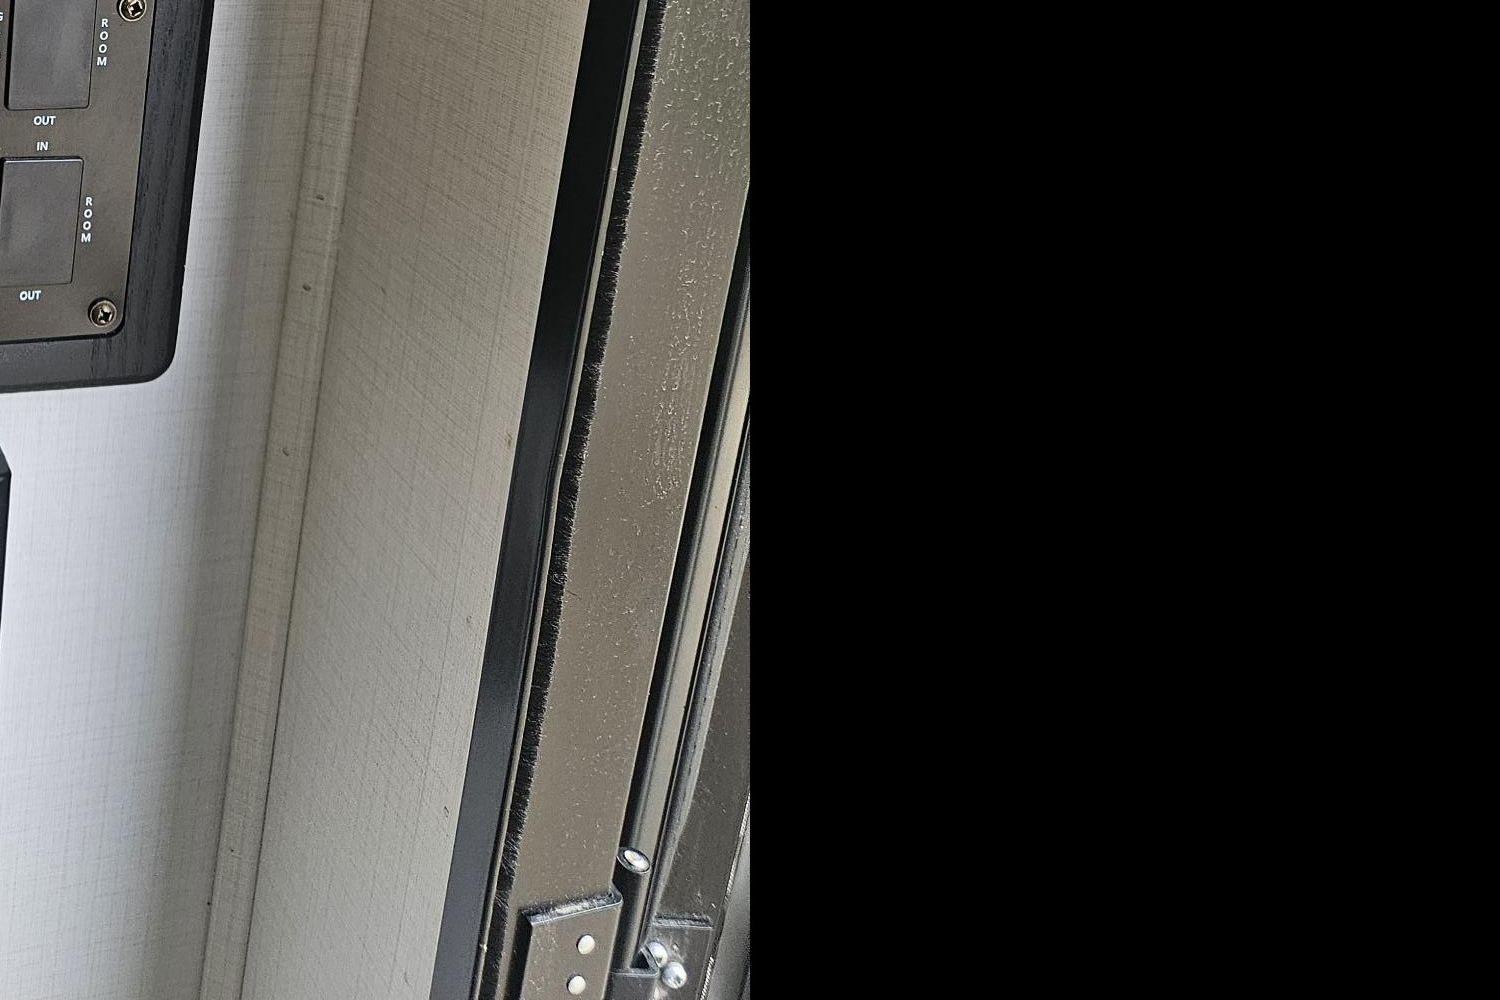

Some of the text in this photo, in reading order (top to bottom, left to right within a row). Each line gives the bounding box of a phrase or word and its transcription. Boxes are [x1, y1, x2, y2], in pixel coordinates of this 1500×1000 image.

[33, 116, 56, 126] OUT
[36, 141, 49, 151] IN
[19, 290, 42, 301] OUT
